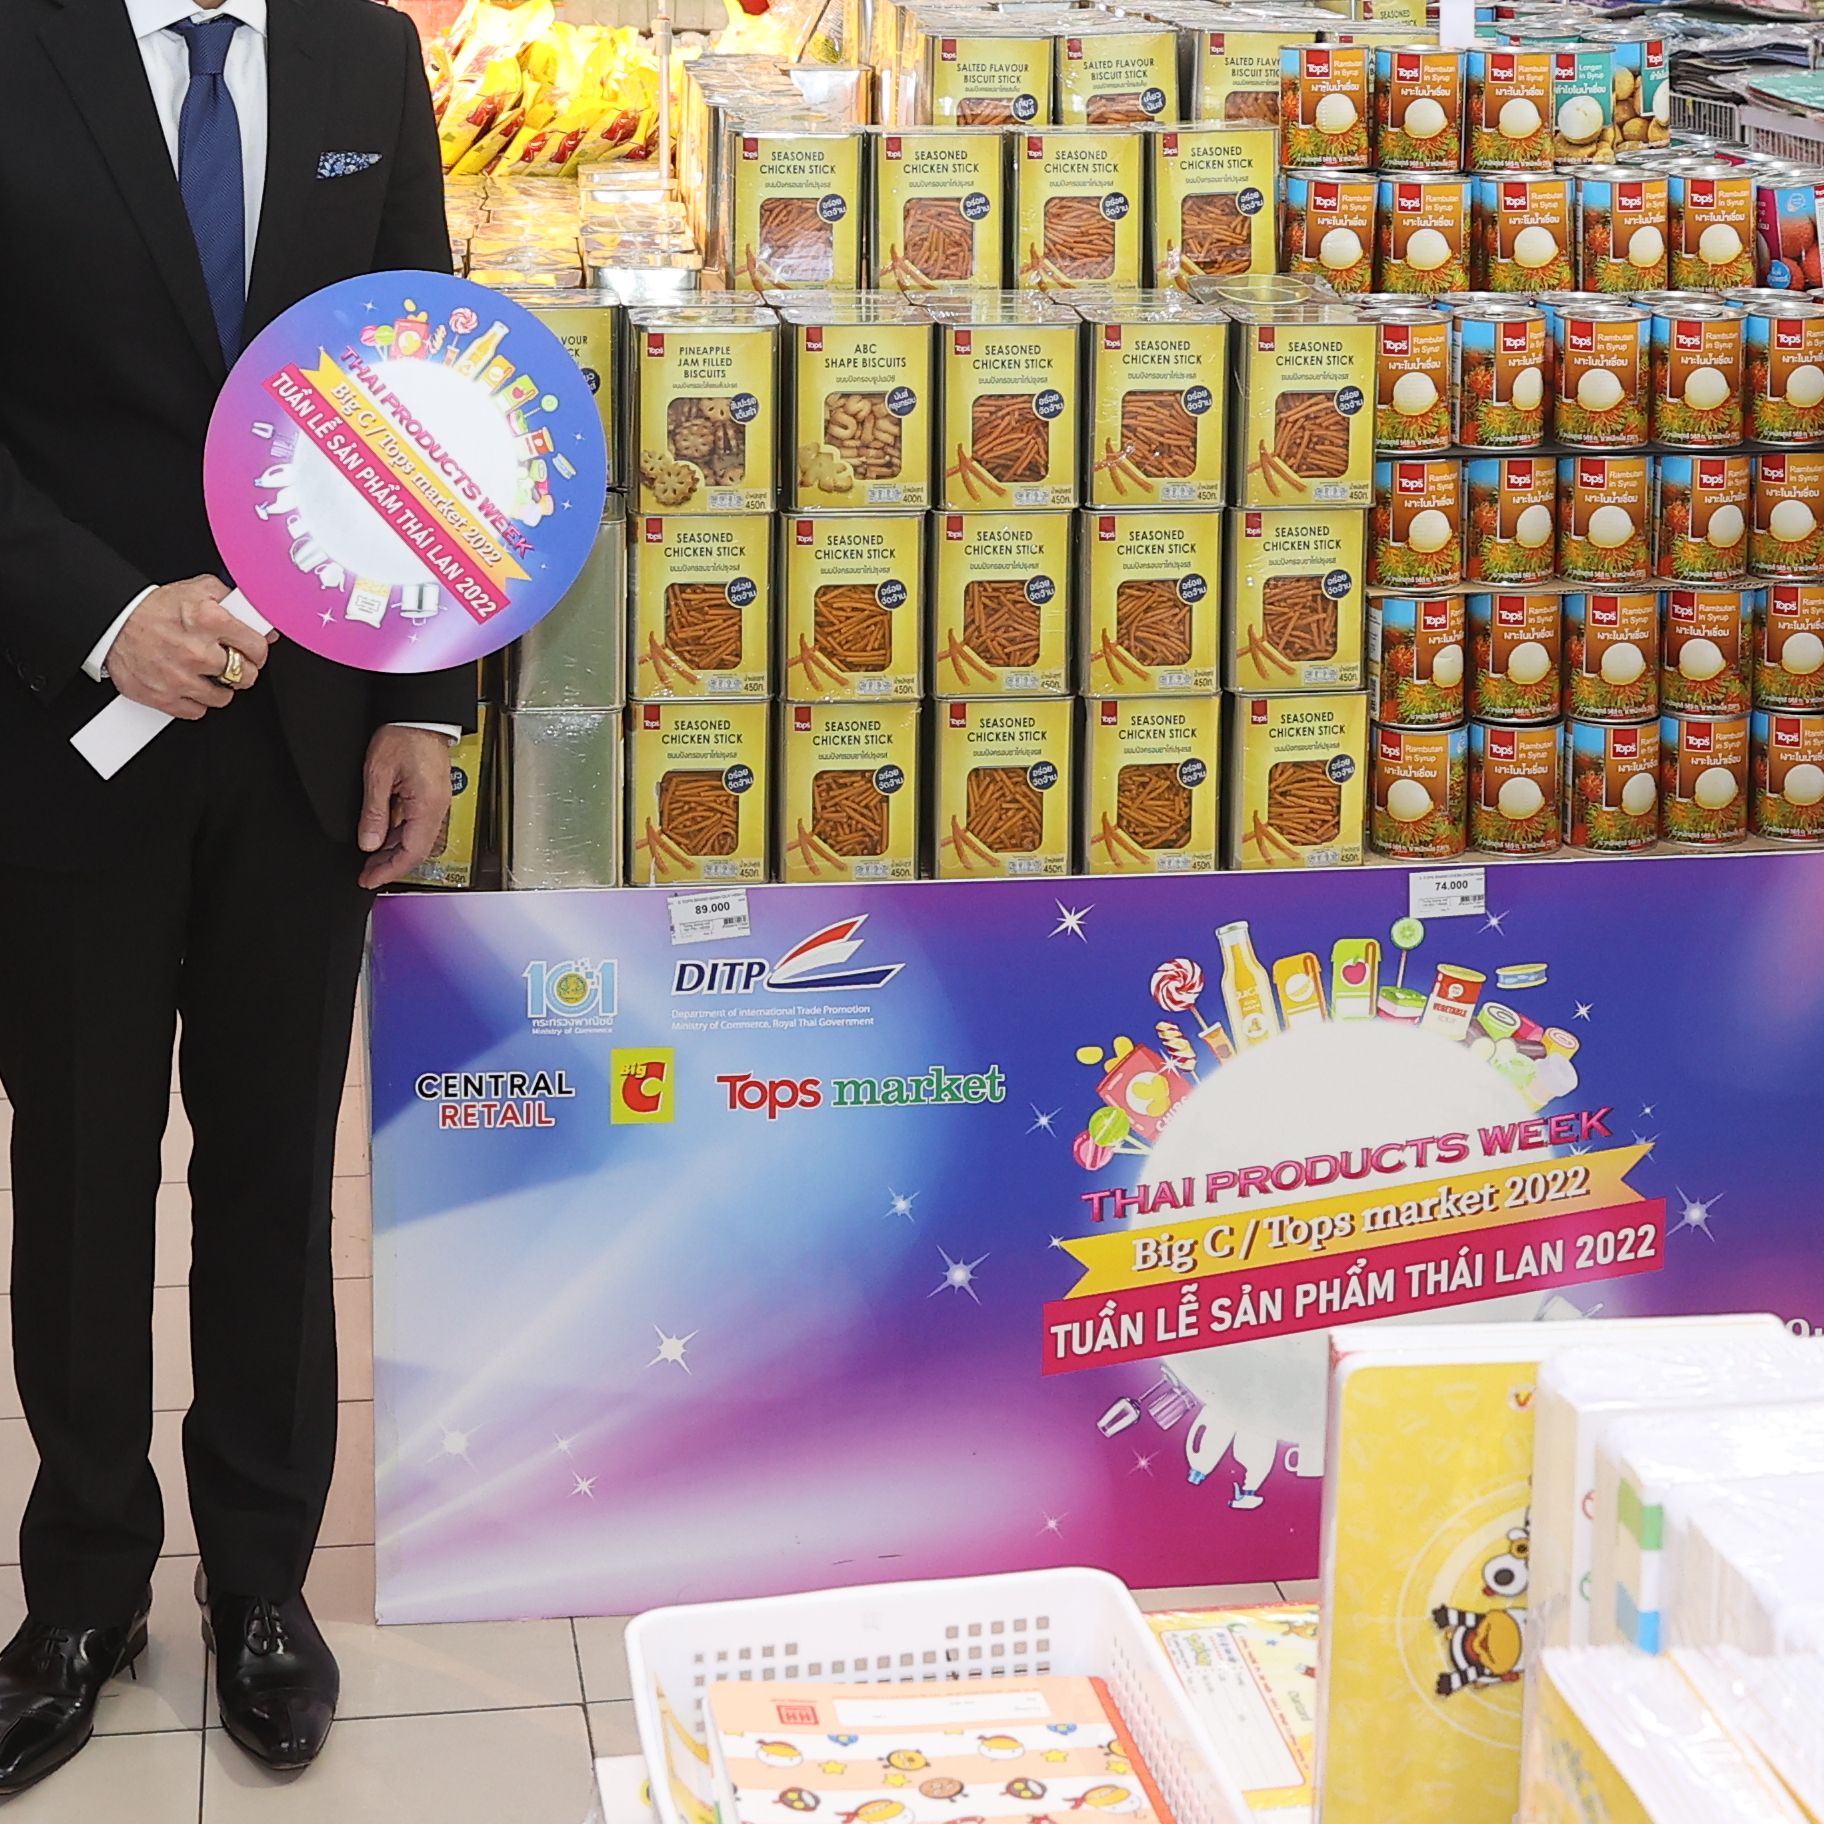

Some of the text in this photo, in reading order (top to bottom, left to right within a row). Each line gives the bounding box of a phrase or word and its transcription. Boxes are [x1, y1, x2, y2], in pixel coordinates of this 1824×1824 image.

[956, 63, 1030, 73] SALTED FLAVOUR
[963, 74, 1022, 85] BISCUIT STICK
[1570, 336, 1592, 348] Tops
[679, 345, 732, 356] PINEAPPLE
[854, 343, 877, 354] ABC
[984, 344, 1041, 356] SEASONED
[677, 357, 733, 367] JAM FILLED
[824, 357, 907, 369] SHAPE BISCUITS
[972, 357, 1054, 370] CHICKEN STICK
[683, 369, 726, 379] BISCUITS
[1435, 880, 1468, 890] 74.000
[696, 902, 730, 914] 89.000
[672, 959, 768, 995] DITP
[672, 1009, 726, 1020] Department
[797, 1005, 822, 1015] Trade
[823, 1005, 871, 1015] Promotion
[671, 1020, 708, 1031] Ministry
[773, 1018, 796, 1029] Royal
[818, 1016, 875, 1027] Government
[416, 1070, 575, 1101] CENTRAL
[715, 1065, 1006, 1121] Tops market
[438, 1102, 556, 1130] RETAIL
[1082, 1105, 1616, 1223] THAI PRODUCTS WEEK
[1131, 1165, 1592, 1274] Big C Tops market 2022
[1050, 1223, 1657, 1360] TUẦN LỄ SẢN PHẨM THÁI LAN 2022
